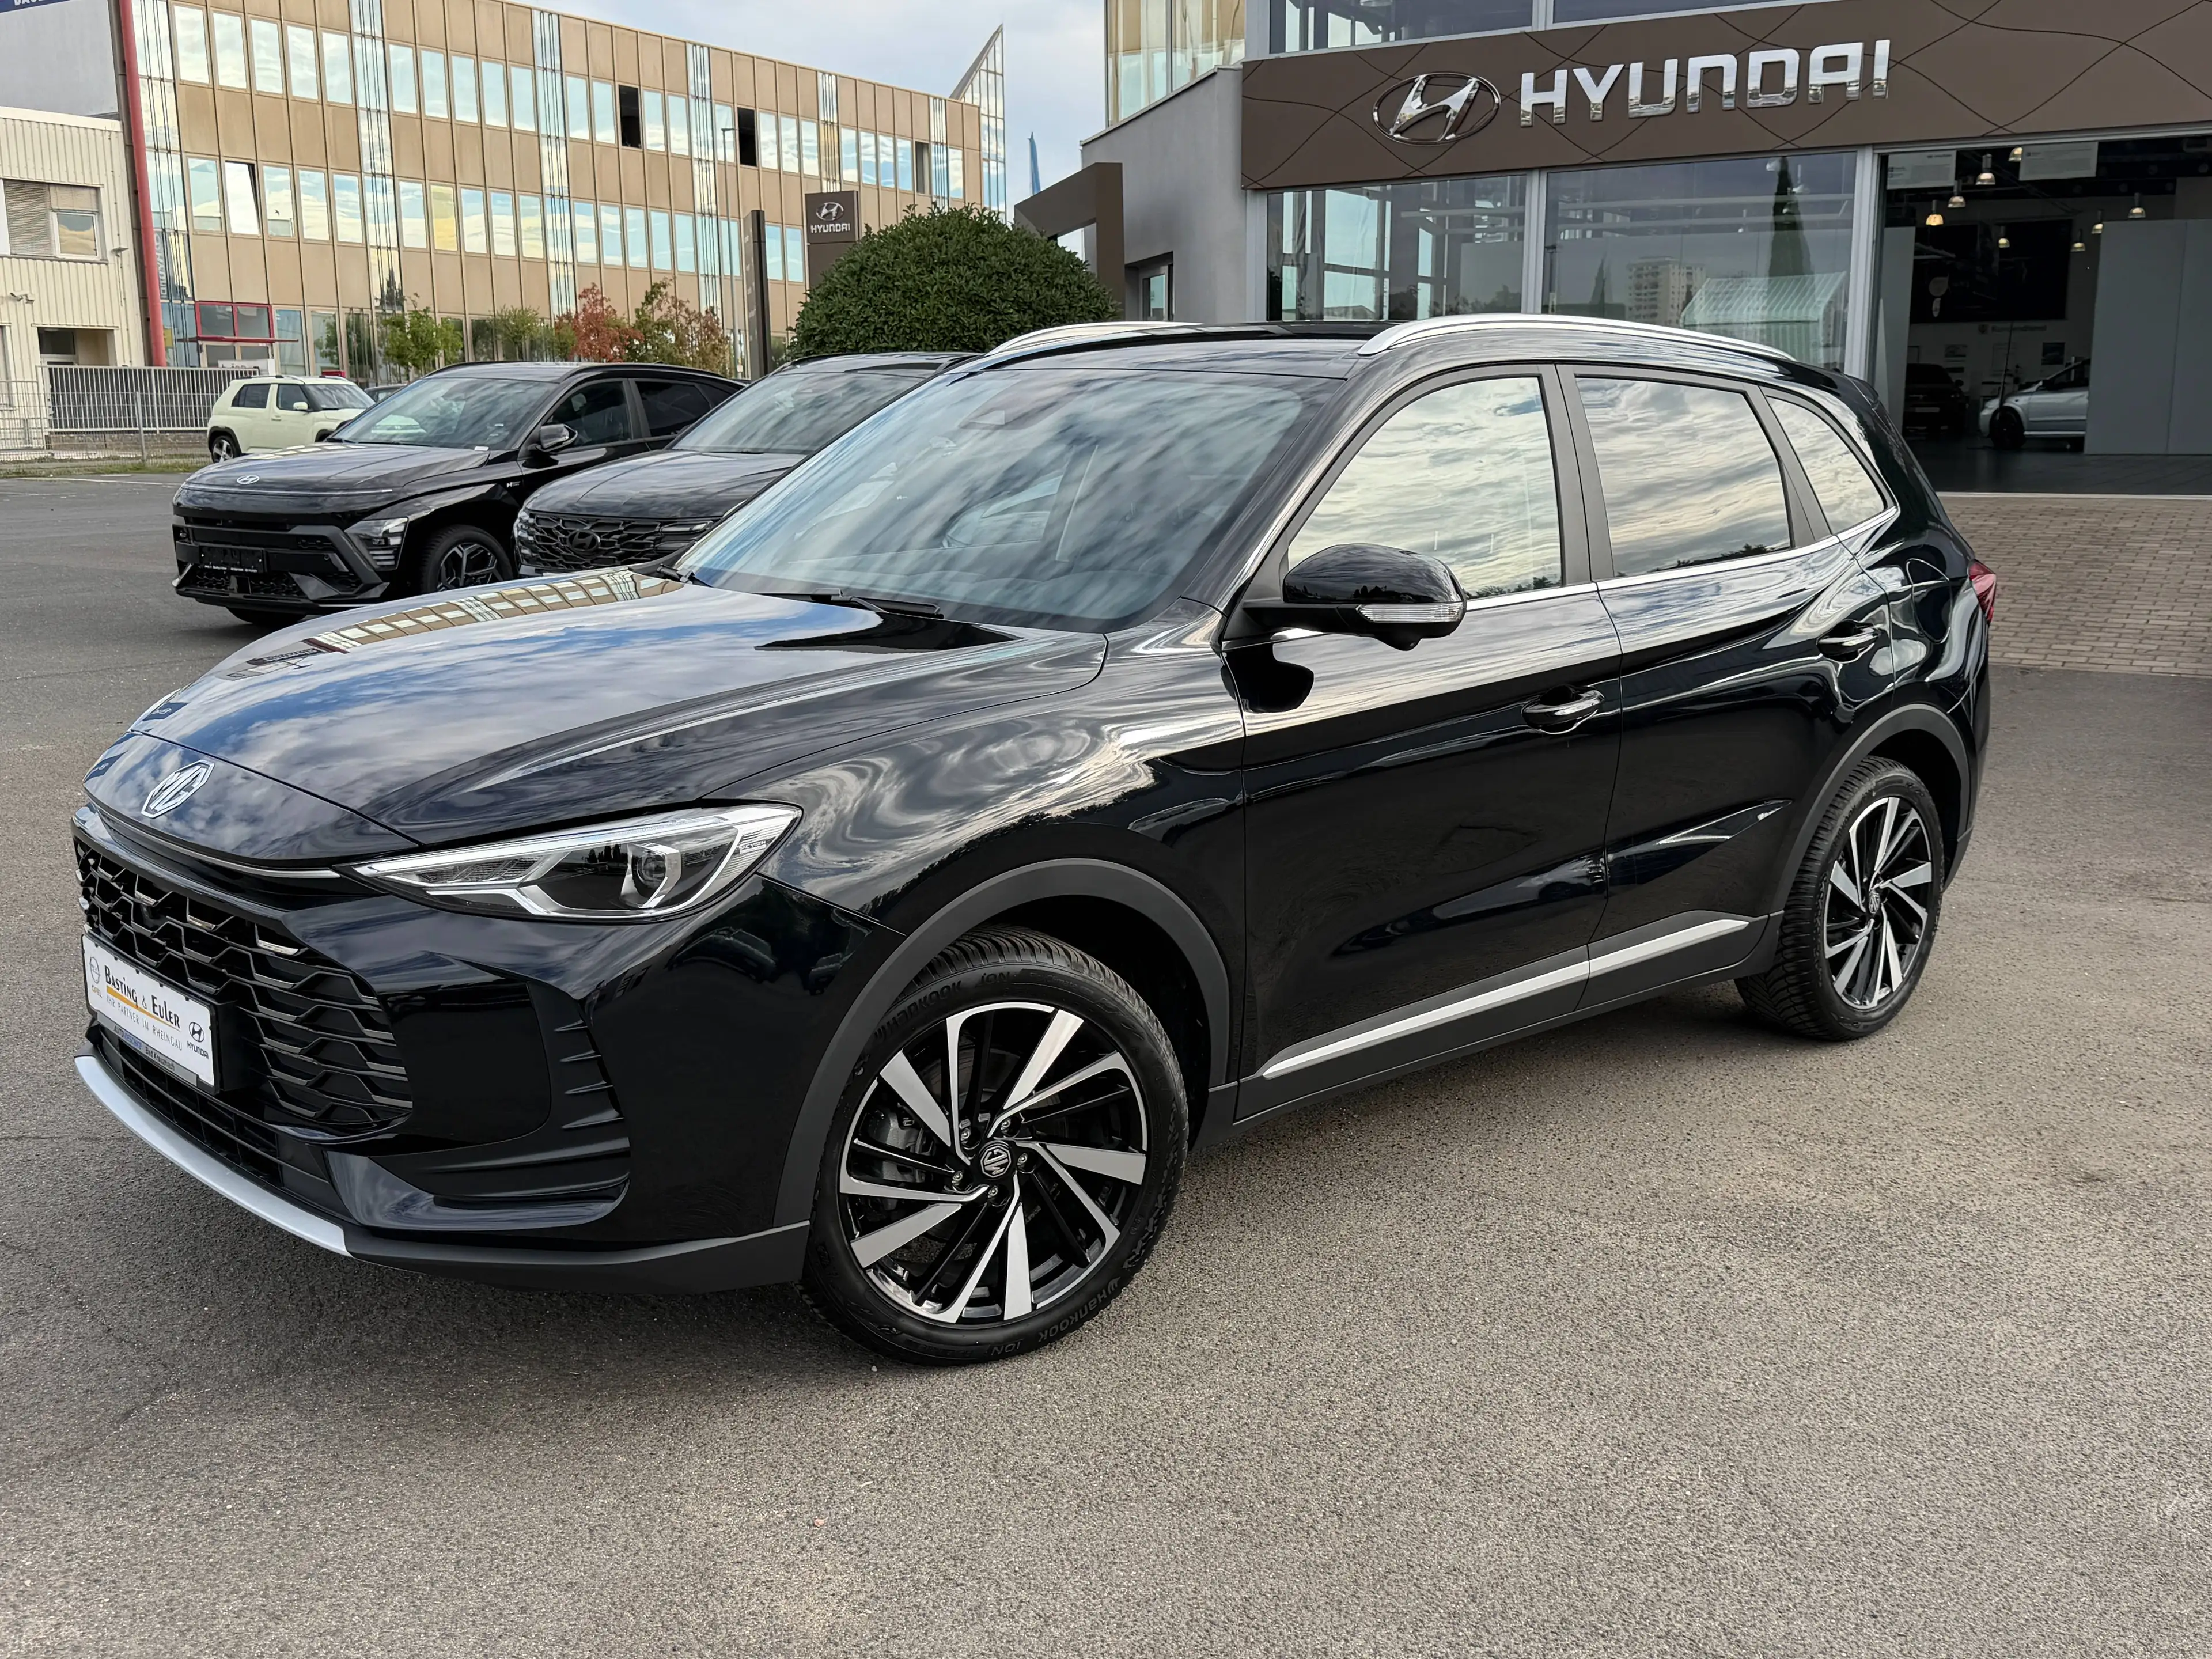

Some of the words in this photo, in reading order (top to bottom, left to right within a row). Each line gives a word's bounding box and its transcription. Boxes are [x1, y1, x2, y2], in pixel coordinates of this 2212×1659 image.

[1520, 39, 1891, 128] HYUNDAI
[810, 223, 850, 233] HYUNDAI
[142, 995, 147, 1009] &
[118, 1002, 139, 1024] PARTNER
[142, 1018, 149, 1031] IM
[153, 1025, 183, 1051] RHEINGAU
[187, 1040, 209, 1059] HYUNDAI
